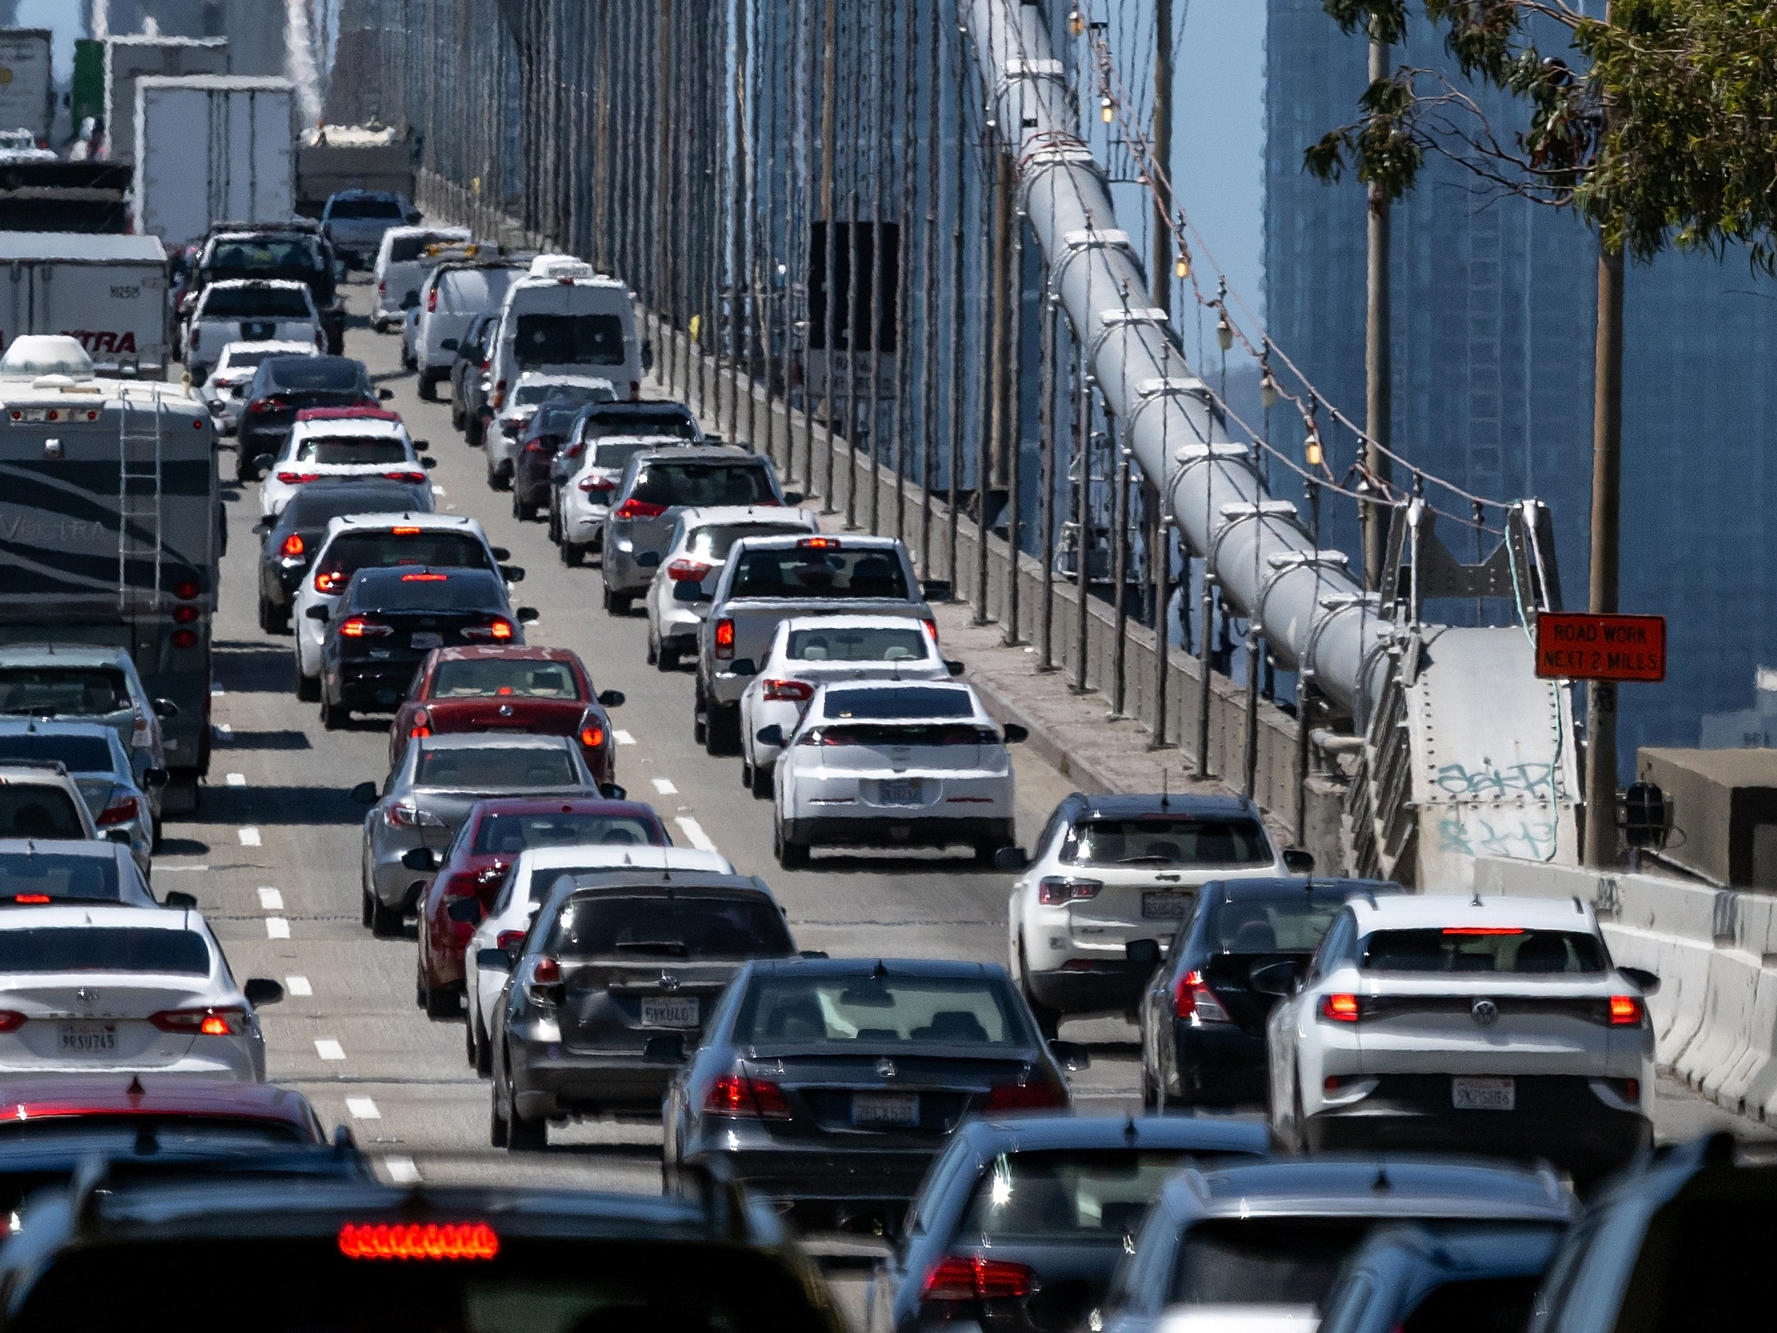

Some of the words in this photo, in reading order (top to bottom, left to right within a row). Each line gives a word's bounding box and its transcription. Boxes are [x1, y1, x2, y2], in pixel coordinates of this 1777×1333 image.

[1554, 623, 1598, 643] ROAD
[1602, 625, 1647, 645] WORK
[1543, 649, 1584, 669] NEXT
[1590, 651, 1602, 670] 2
[1606, 652, 1658, 670] MILES
